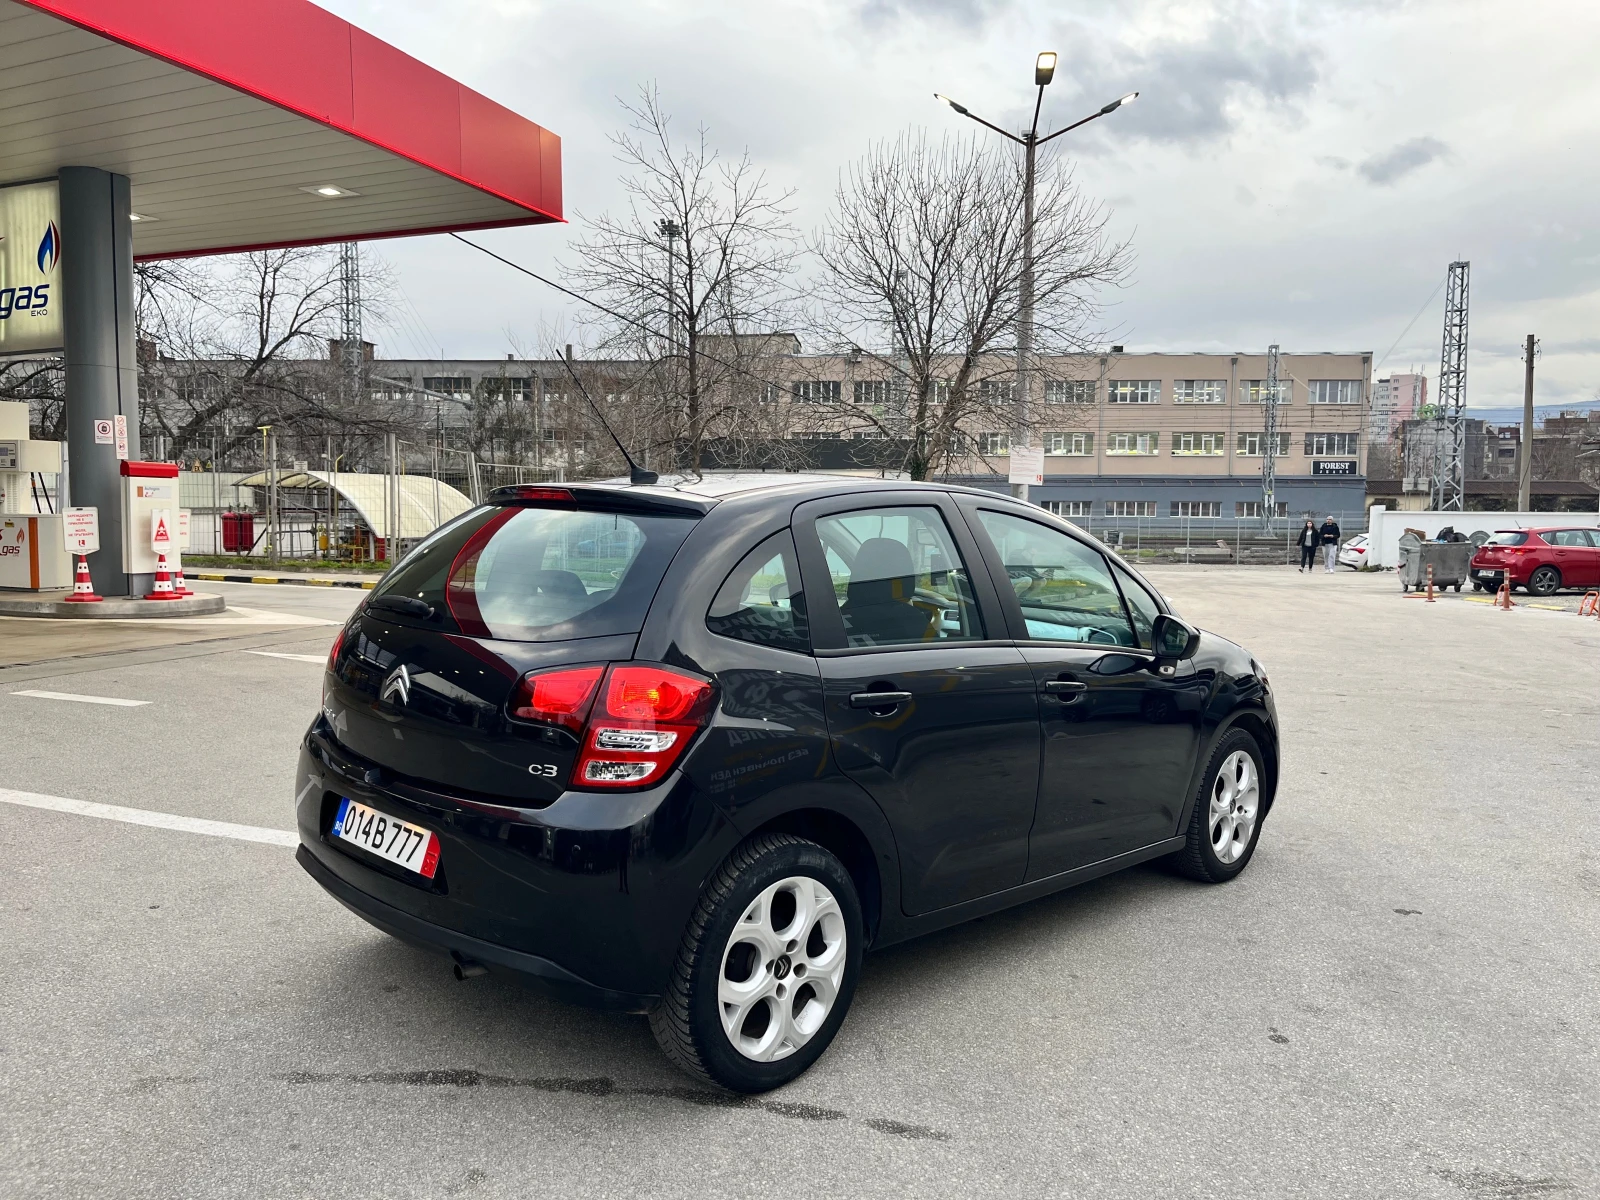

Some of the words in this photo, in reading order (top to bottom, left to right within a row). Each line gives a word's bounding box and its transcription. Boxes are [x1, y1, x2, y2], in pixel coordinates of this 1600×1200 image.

[31, 309, 48, 317] EKO
[1319, 462, 1350, 470] FOREST
[528, 763, 558, 777] C3
[334, 821, 343, 831] BG
[344, 805, 425, 862] 014B777
